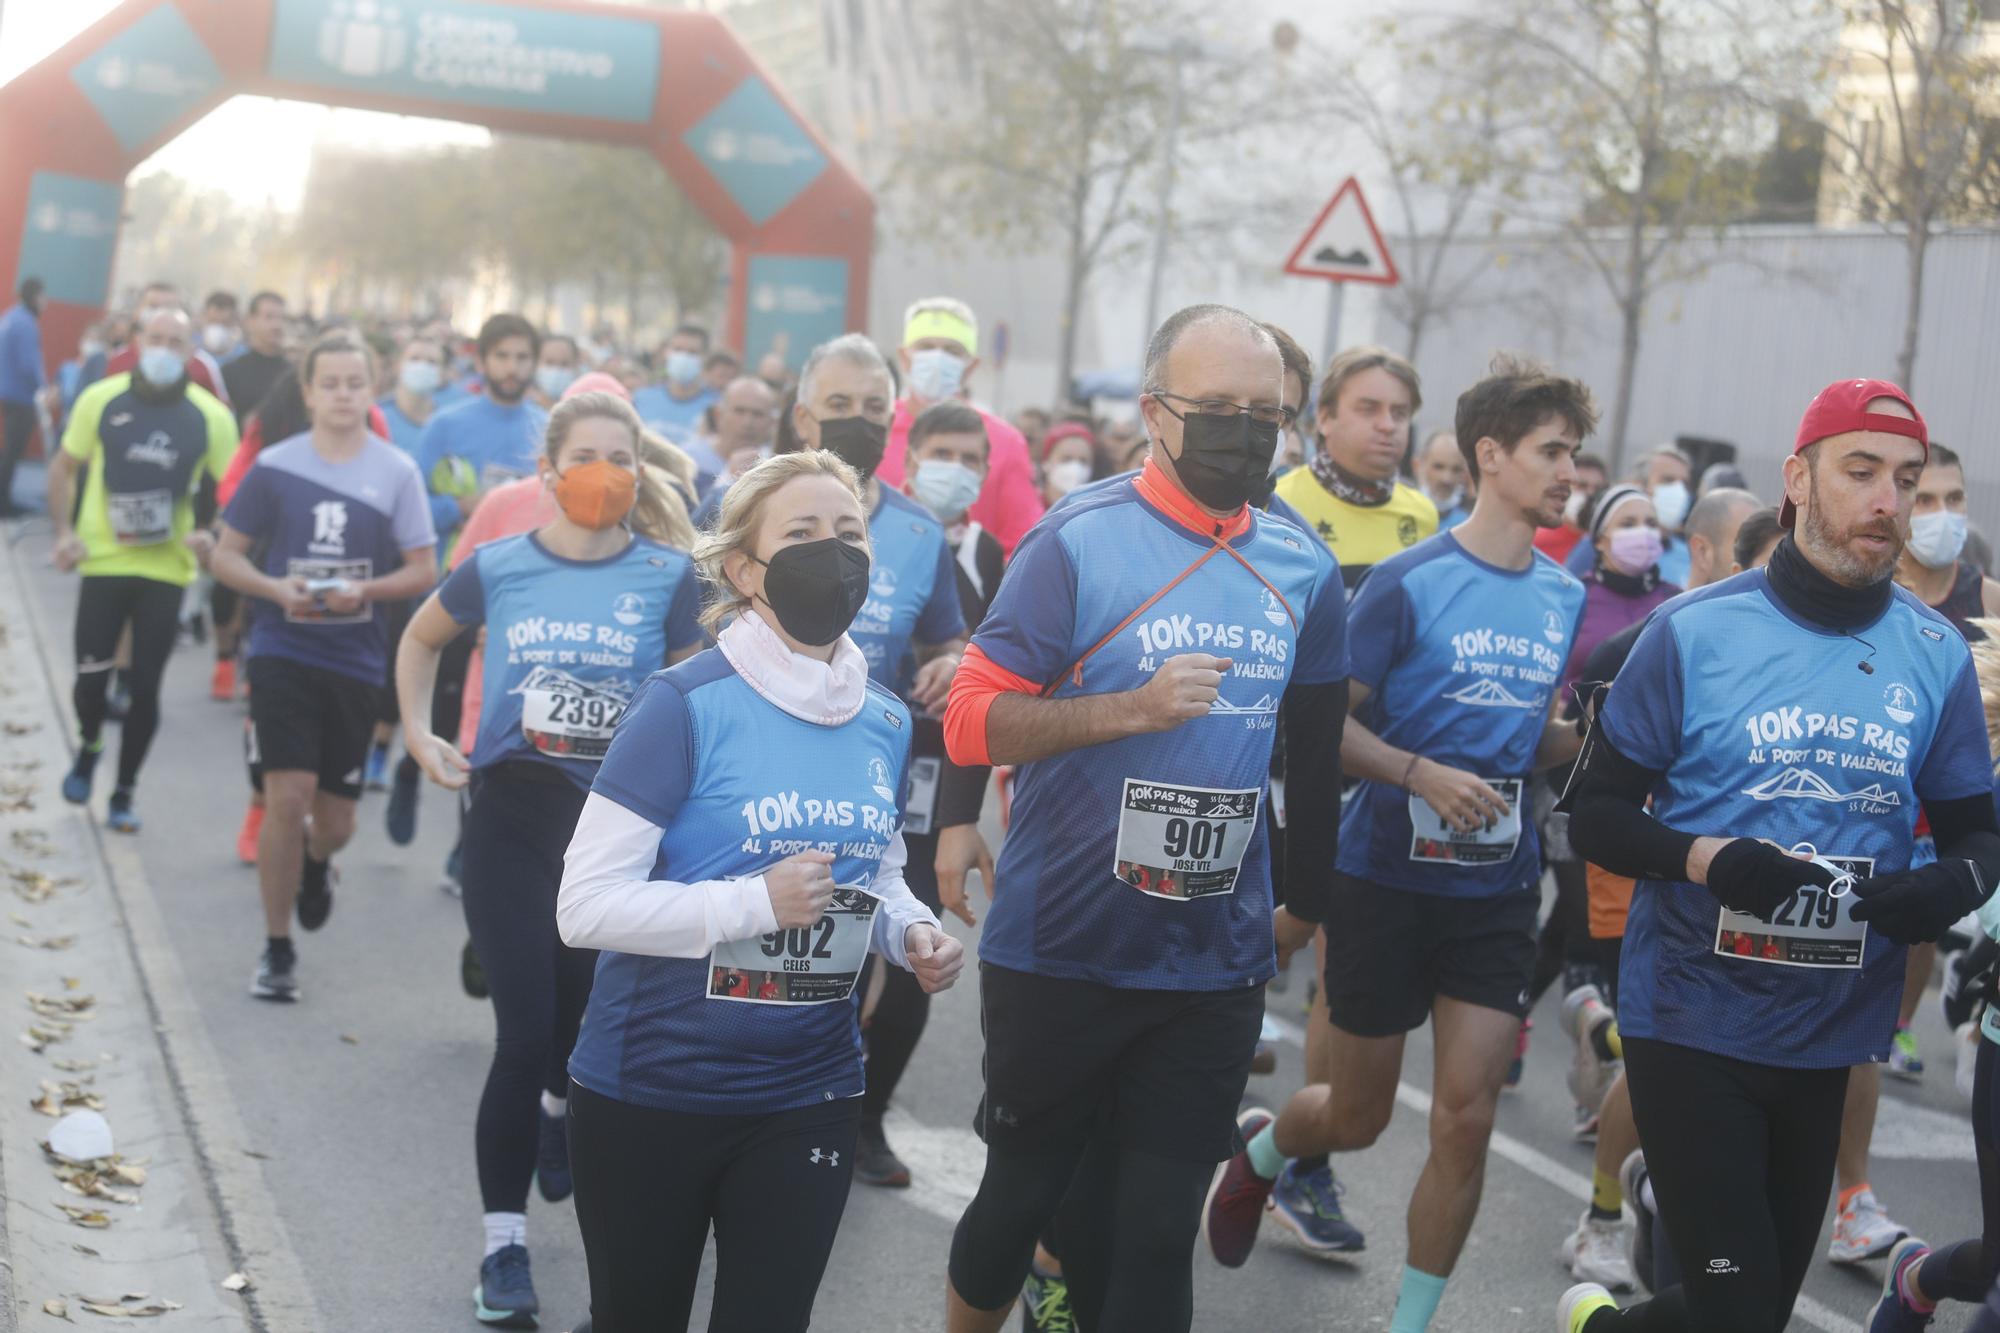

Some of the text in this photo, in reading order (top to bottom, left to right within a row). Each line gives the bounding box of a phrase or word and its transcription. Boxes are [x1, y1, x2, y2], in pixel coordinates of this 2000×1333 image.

[506, 616, 639, 654] 10K PAS RAS
[1137, 613, 1288, 662] 10K PAS RAS
[507, 648, 633, 668] AL PORT DE VALÈNCIA
[1138, 656, 1156, 672] AL
[1451, 628, 1560, 672] 10K PAS RAS
[1233, 657, 1285, 681] VALÈNCIA
[1452, 660, 1466, 673] AL
[1471, 661, 1500, 677] PORT
[1502, 664, 1516, 678] DE
[546, 693, 623, 729] 2392
[1746, 705, 1911, 759] 10K PAS RAS
[1748, 748, 1905, 777] AL PORT DE VALÈNCIA
[1129, 786, 1200, 809] 10K PAS RAS
[1158, 805, 1167, 813] DE
[1169, 805, 1197, 816] VALÈNCIA
[741, 790, 896, 842] 10K PAS RAS
[741, 837, 763, 855] AL
[769, 839, 813, 856] PORT
[817, 840, 838, 854] DE
[1163, 817, 1228, 860] 901
[1172, 859, 1212, 872] JOSE VTE
[1762, 888, 1839, 930] 279
[760, 914, 836, 959] 902
[782, 959, 811, 972] CELES
